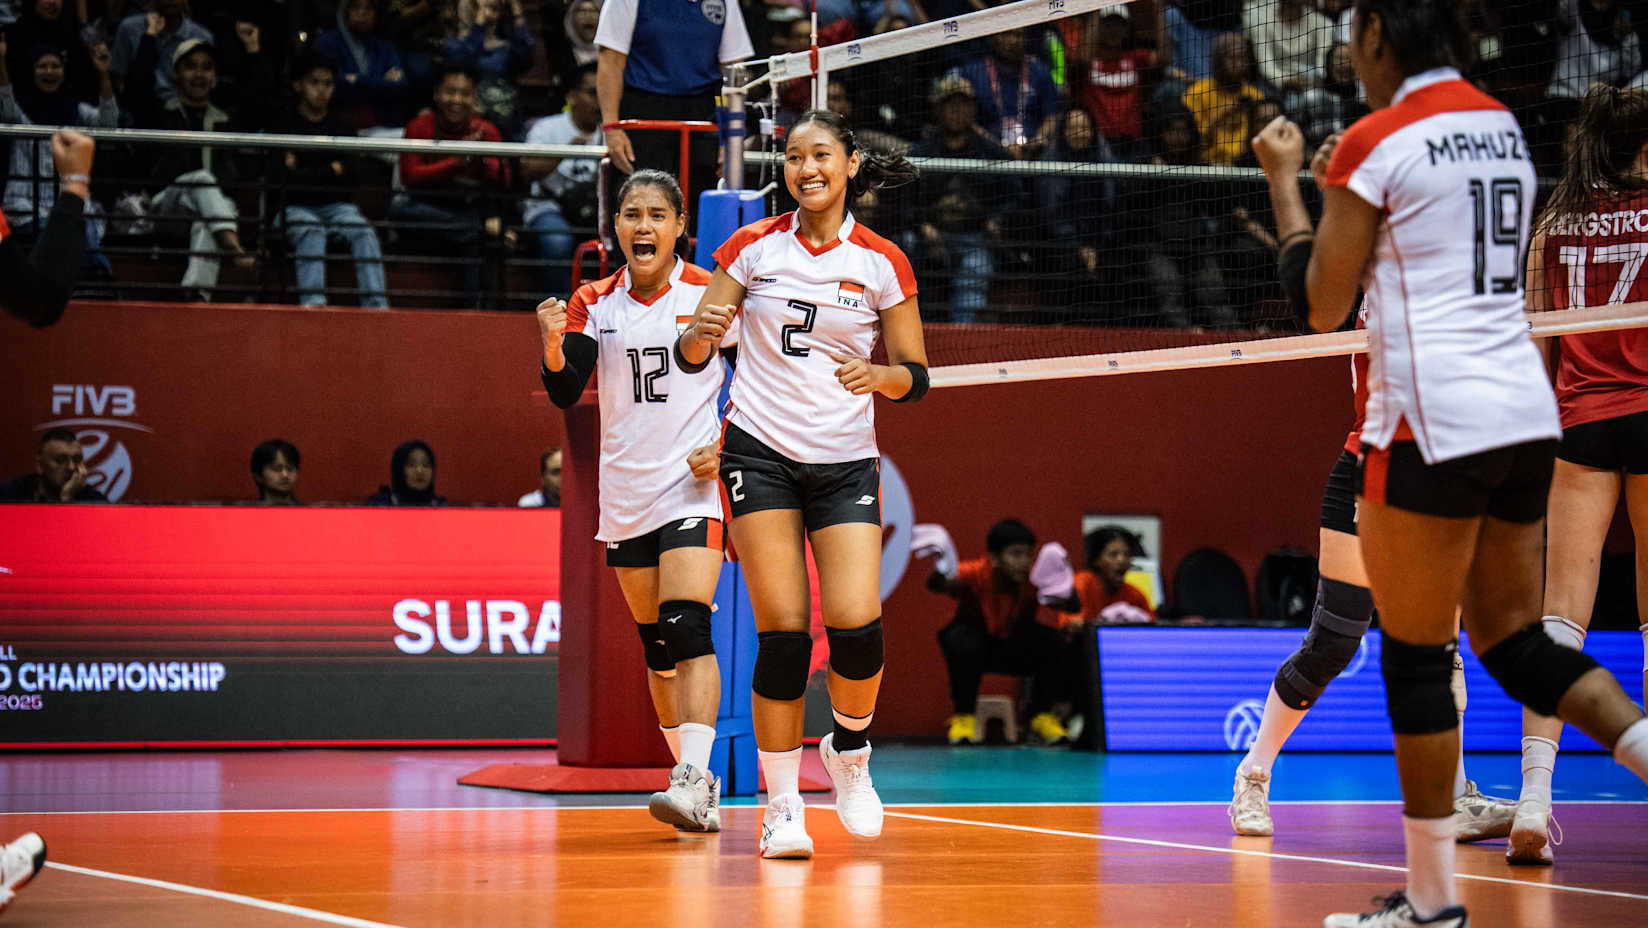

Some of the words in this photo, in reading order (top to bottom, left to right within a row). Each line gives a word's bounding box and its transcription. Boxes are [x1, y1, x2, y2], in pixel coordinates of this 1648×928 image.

[1425, 131, 1530, 166] MAHUZ
[1468, 178, 1523, 294] 19
[1559, 242, 1648, 309] 17
[838, 297, 859, 308] INA
[781, 299, 817, 357] 2
[626, 346, 669, 403] 12
[52, 385, 136, 415] FIVB
[729, 470, 745, 502] 2
[393, 599, 562, 654] SURA
[18, 662, 226, 692] CHAMPIONSHIP
[0, 694, 43, 710] 2025
